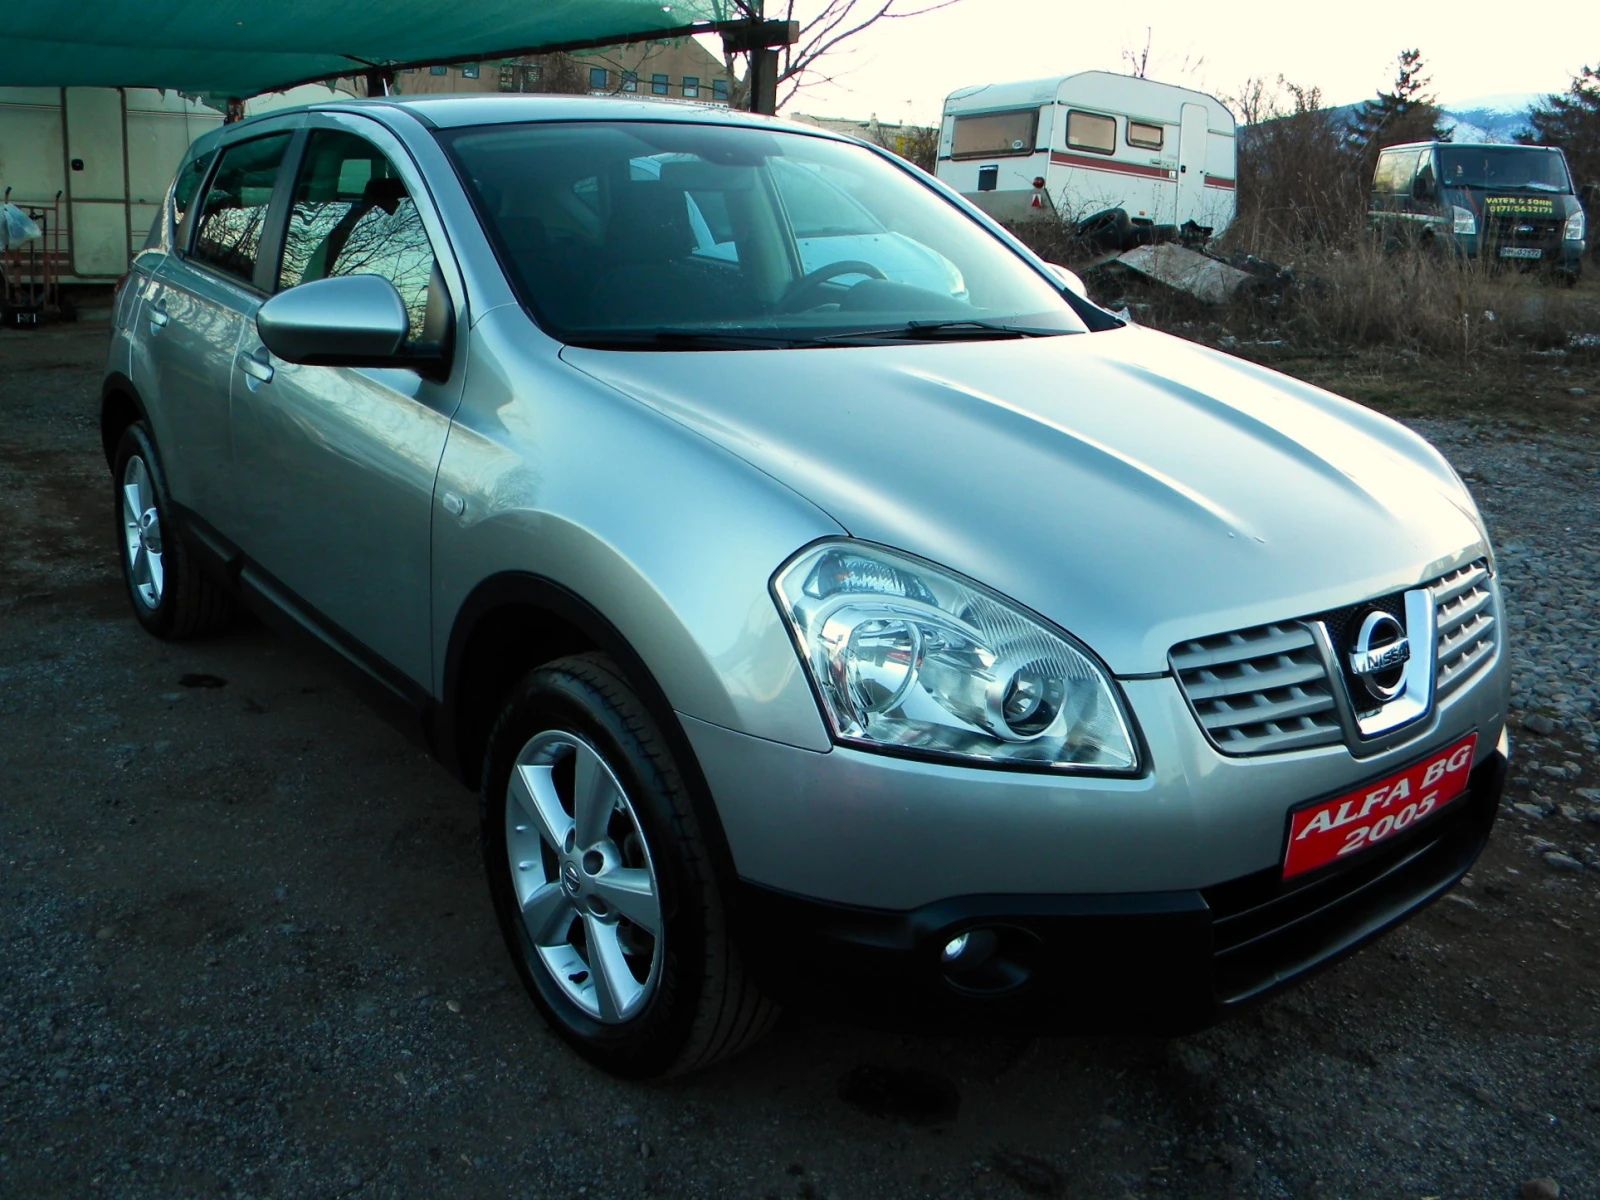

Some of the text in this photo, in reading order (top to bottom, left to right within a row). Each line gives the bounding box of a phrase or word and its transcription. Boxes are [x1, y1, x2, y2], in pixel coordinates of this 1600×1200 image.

[1485, 197, 1516, 205] VATER
[1295, 744, 1472, 841] ALFA BG
[1336, 789, 1439, 856] 2005
